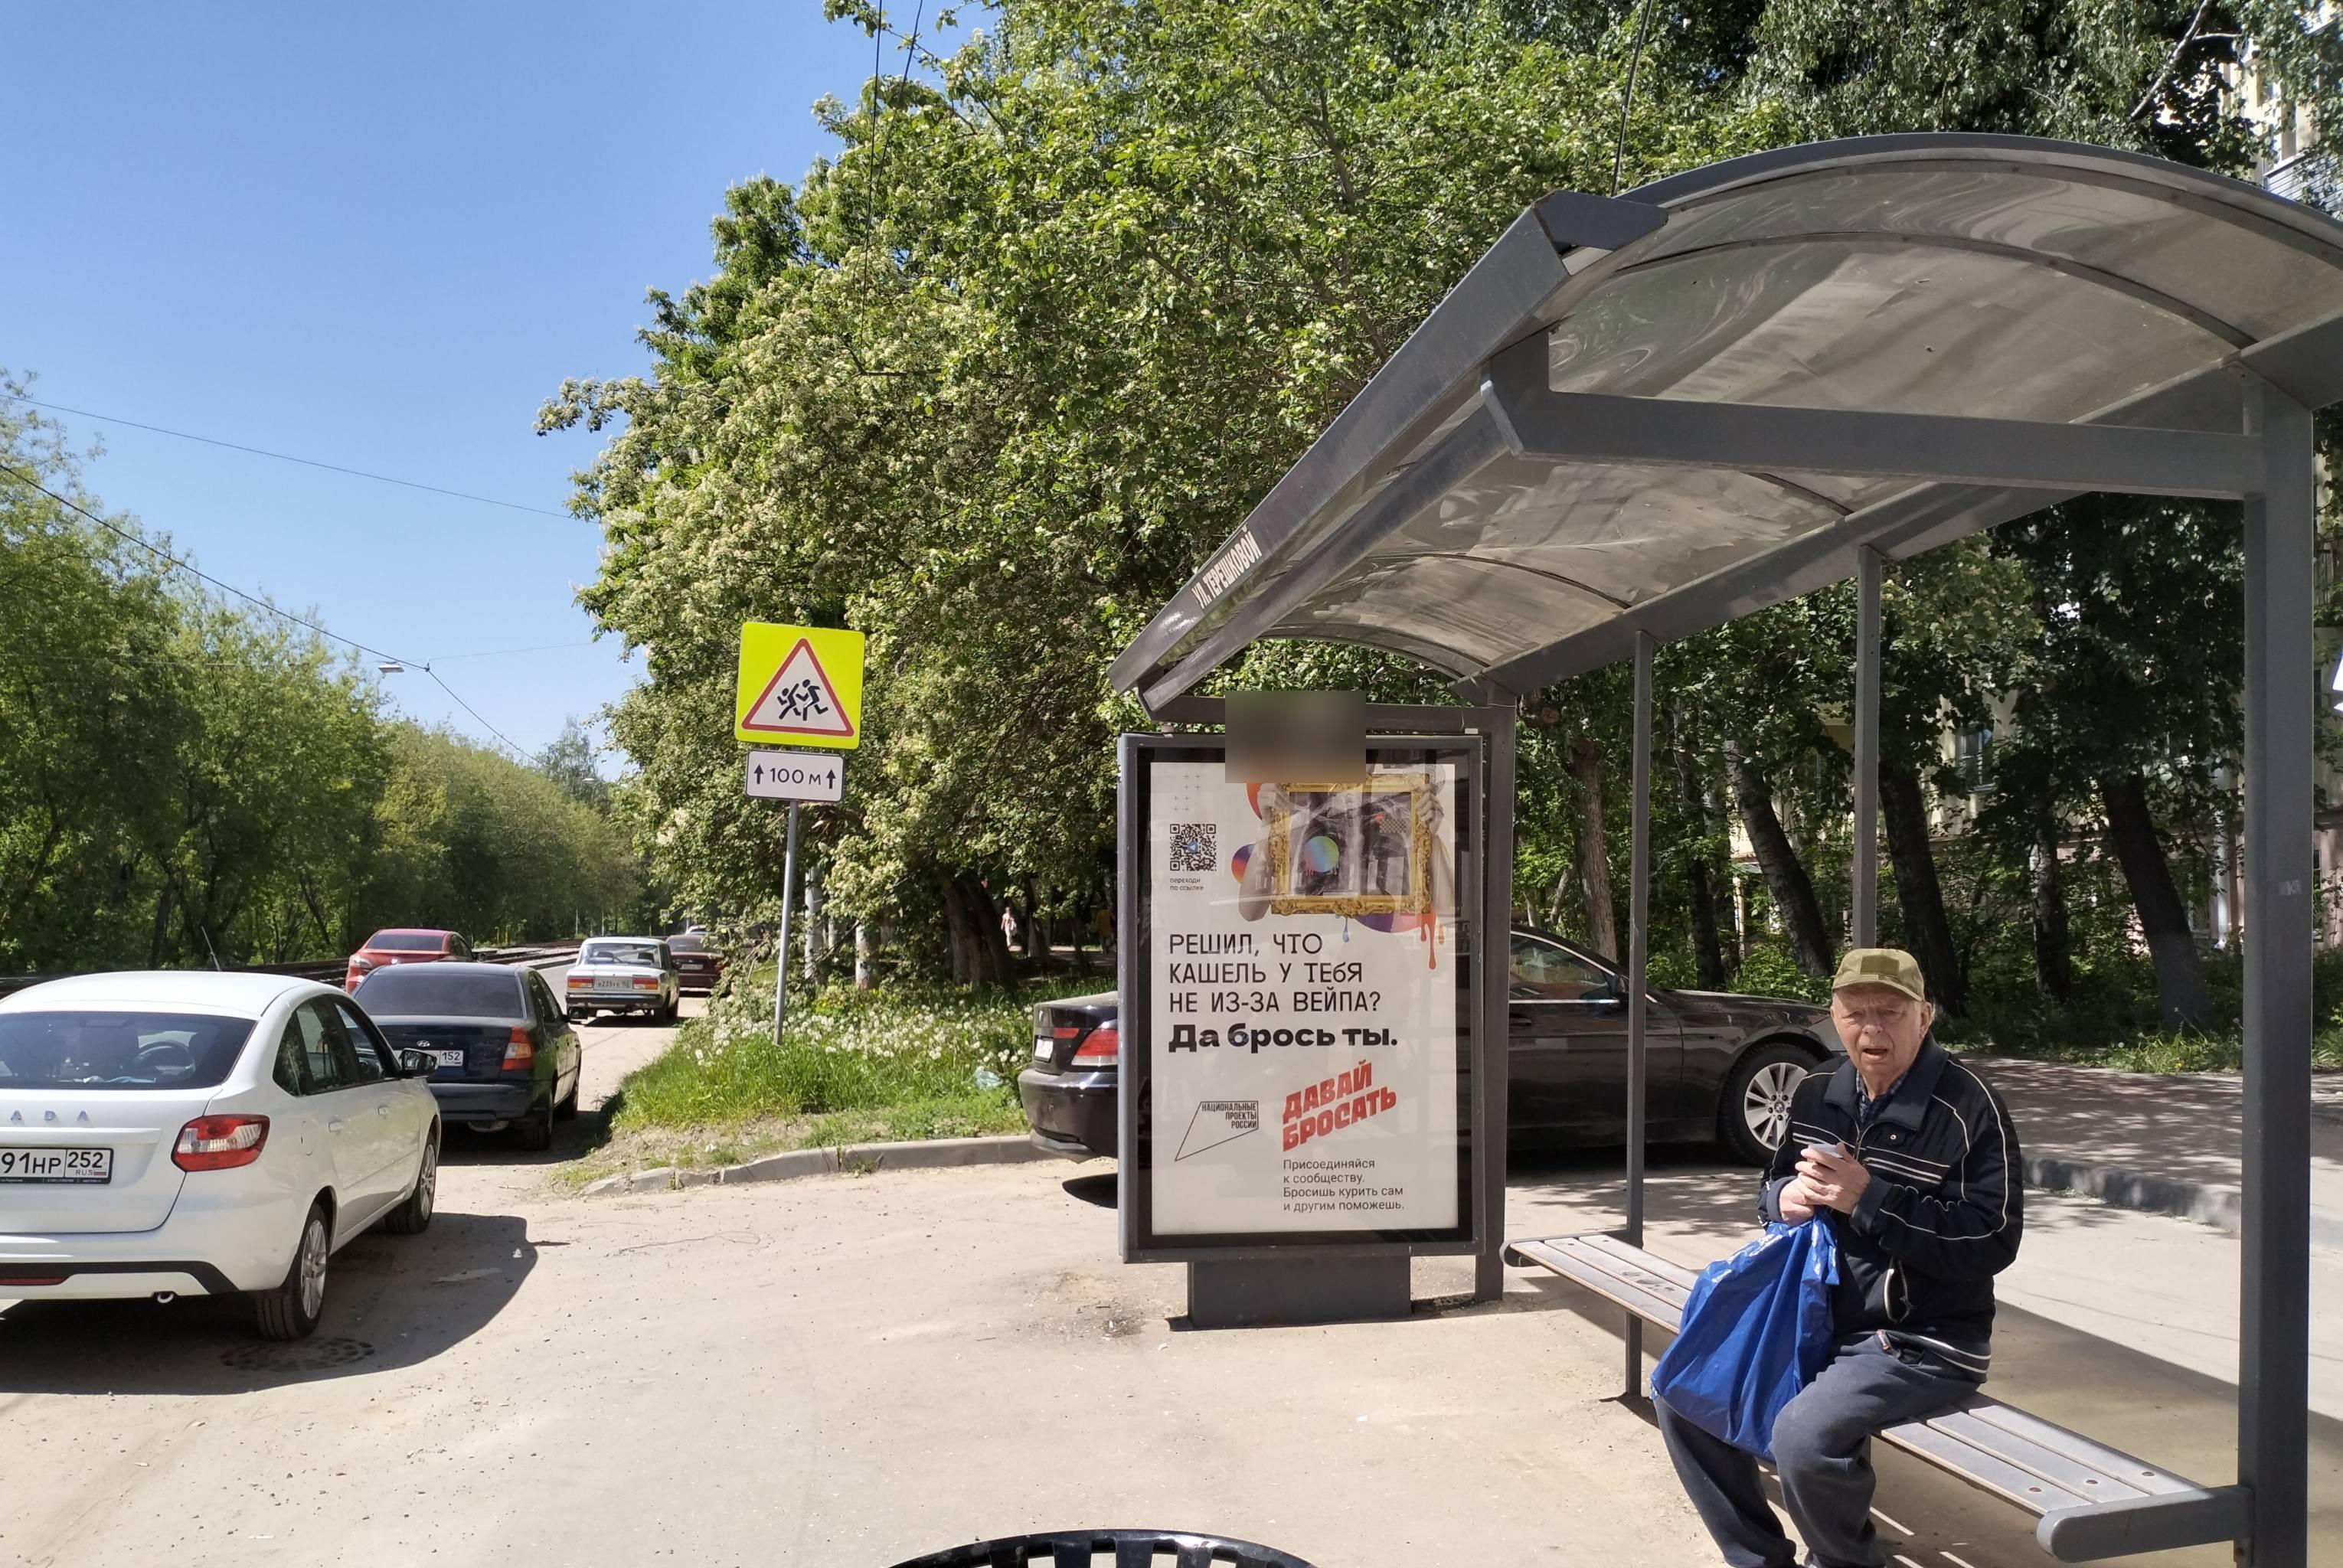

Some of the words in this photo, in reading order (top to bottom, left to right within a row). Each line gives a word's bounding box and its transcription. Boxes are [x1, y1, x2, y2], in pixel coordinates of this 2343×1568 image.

[1191, 581, 1212, 609] УЛ.
[1202, 522, 1262, 599] ТЕРЕШКОВОЙ
[770, 767, 804, 784] 100
[1169, 933, 1260, 957] РЕШИЛ,
[1273, 933, 1323, 955] ЧТО
[1169, 962, 1266, 984] КАШЕЛЬ
[1279, 962, 1292, 984] У
[1169, 992, 1198, 1013] НЕ
[1211, 991, 1279, 1013] ИЗ-ЗА
[1293, 986, 1381, 1012] ВЕЙПА?
[1168, 1024, 1220, 1053] Да
[1227, 1023, 1336, 1054] брось
[1341, 1028, 1398, 1047] ты.
[442, 1051, 460, 1061] 152
[1283, 1059, 1372, 1125] ДАВАЙ
[1202, 1102, 1256, 1112] НАЦИОНАЛЬНЫЕ
[1226, 1112, 1256, 1120] ПРОЕКТЫ
[1283, 1086, 1397, 1152] БРОСАТЬ
[1231, 1120, 1256, 1129] РОССИИ
[67, 1152, 103, 1168] 252
[1283, 1158, 1375, 1171] Присоединяйся
[1283, 1175, 1289, 1184] к
[1293, 1172, 1364, 1184] сообществу.
[1283, 1187, 1335, 1199] Бросишь
[1339, 1187, 1378, 1198] курить
[1381, 1187, 1404, 1196] сам
[1293, 1202, 1335, 1213] другим
[1339, 1200, 1404, 1210] поможешь.
